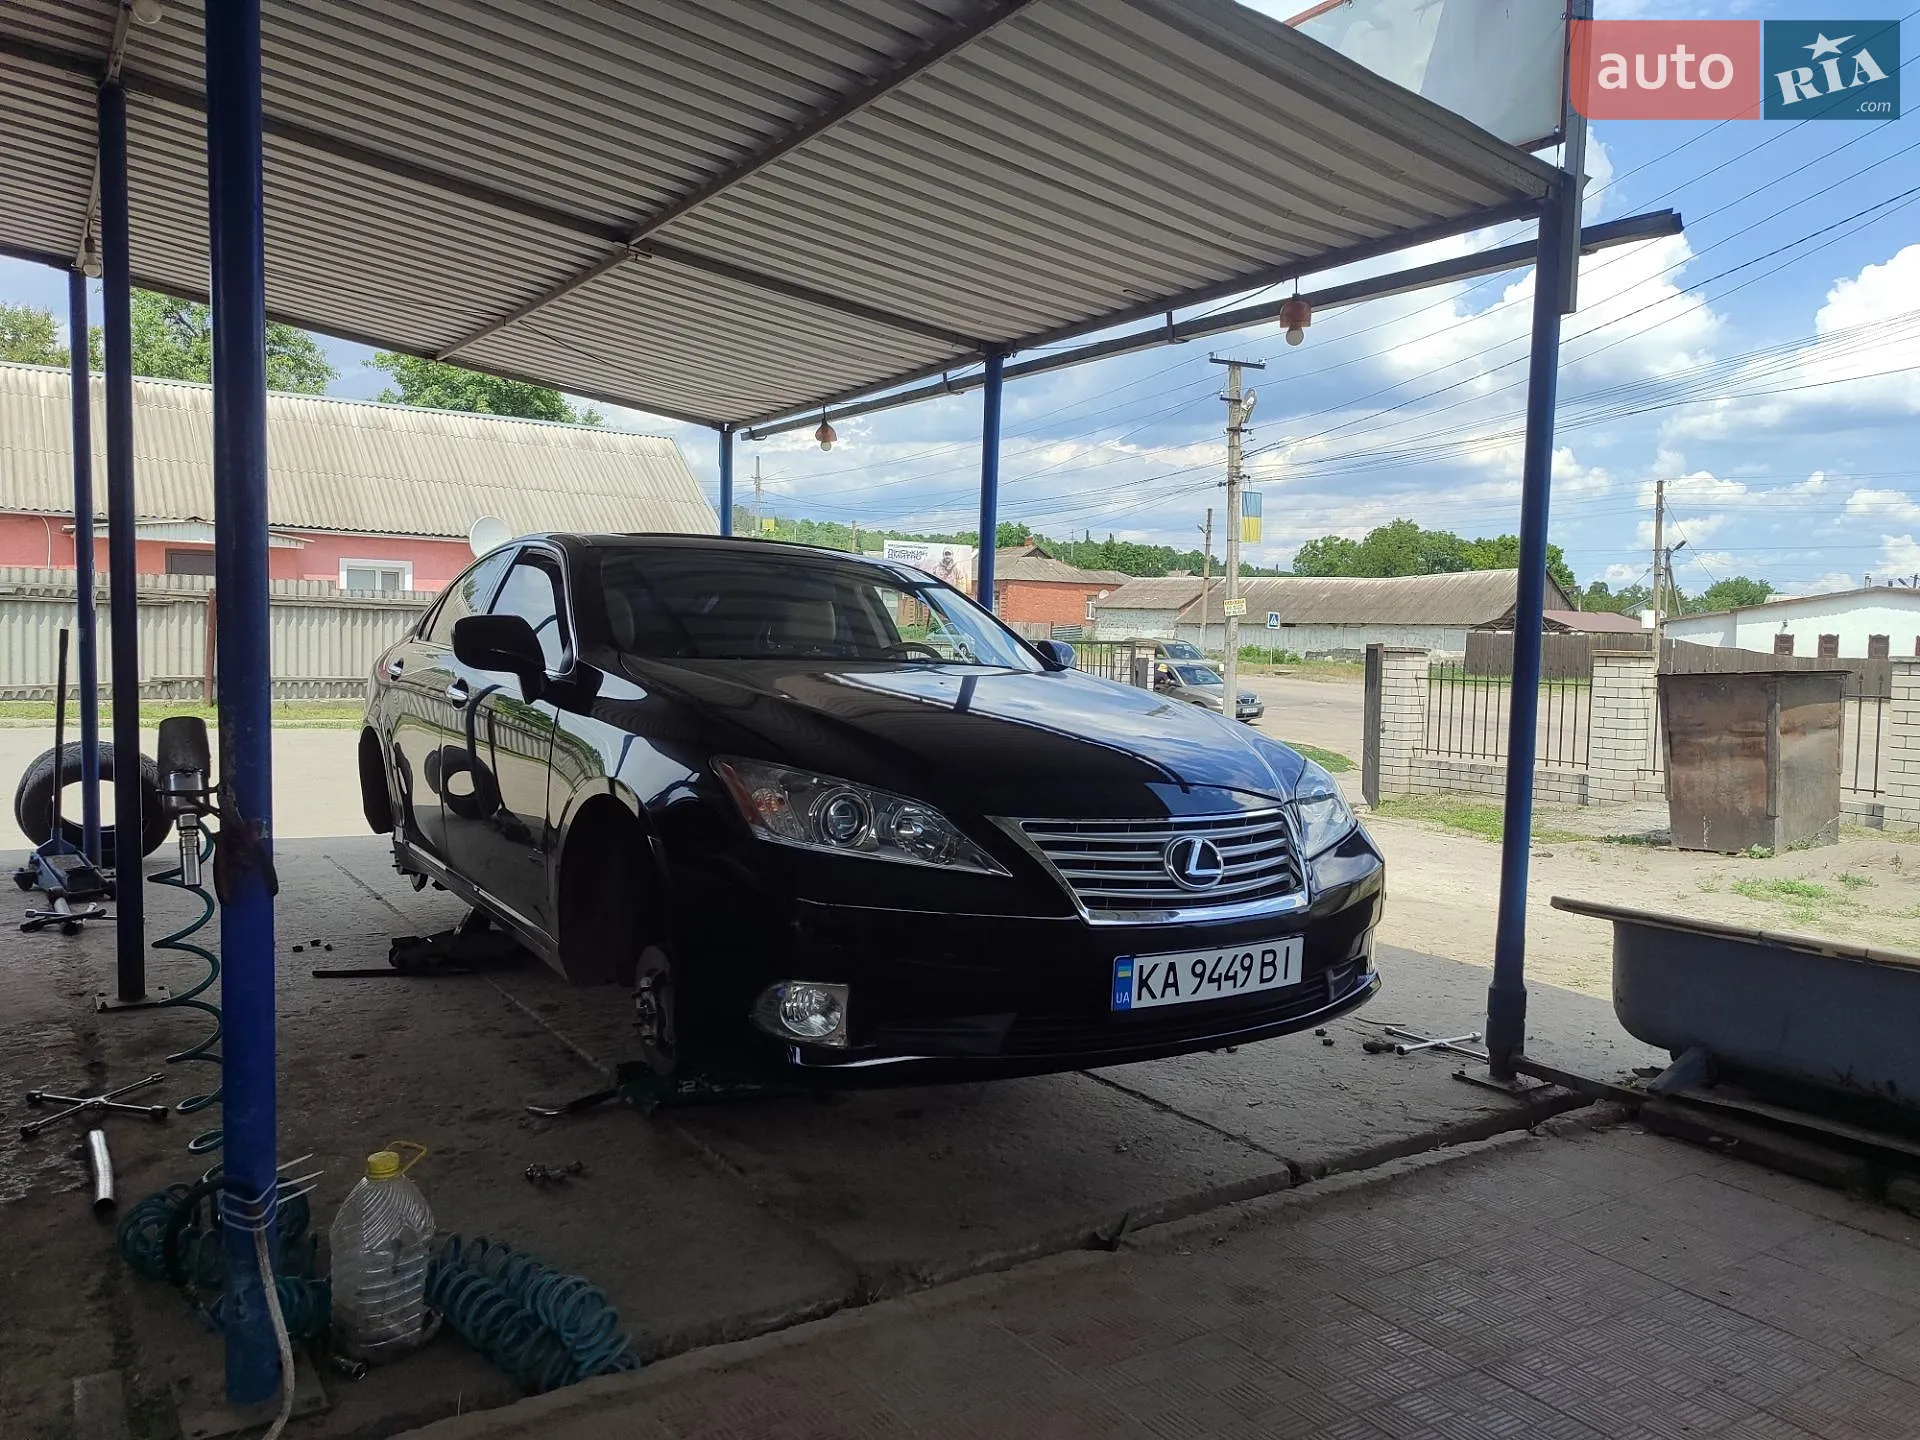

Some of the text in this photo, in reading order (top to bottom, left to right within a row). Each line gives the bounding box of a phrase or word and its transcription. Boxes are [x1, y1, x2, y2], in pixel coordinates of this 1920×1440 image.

[1136, 946, 1291, 1001] KA 9449 BI
[1115, 991, 1130, 1005] UA
